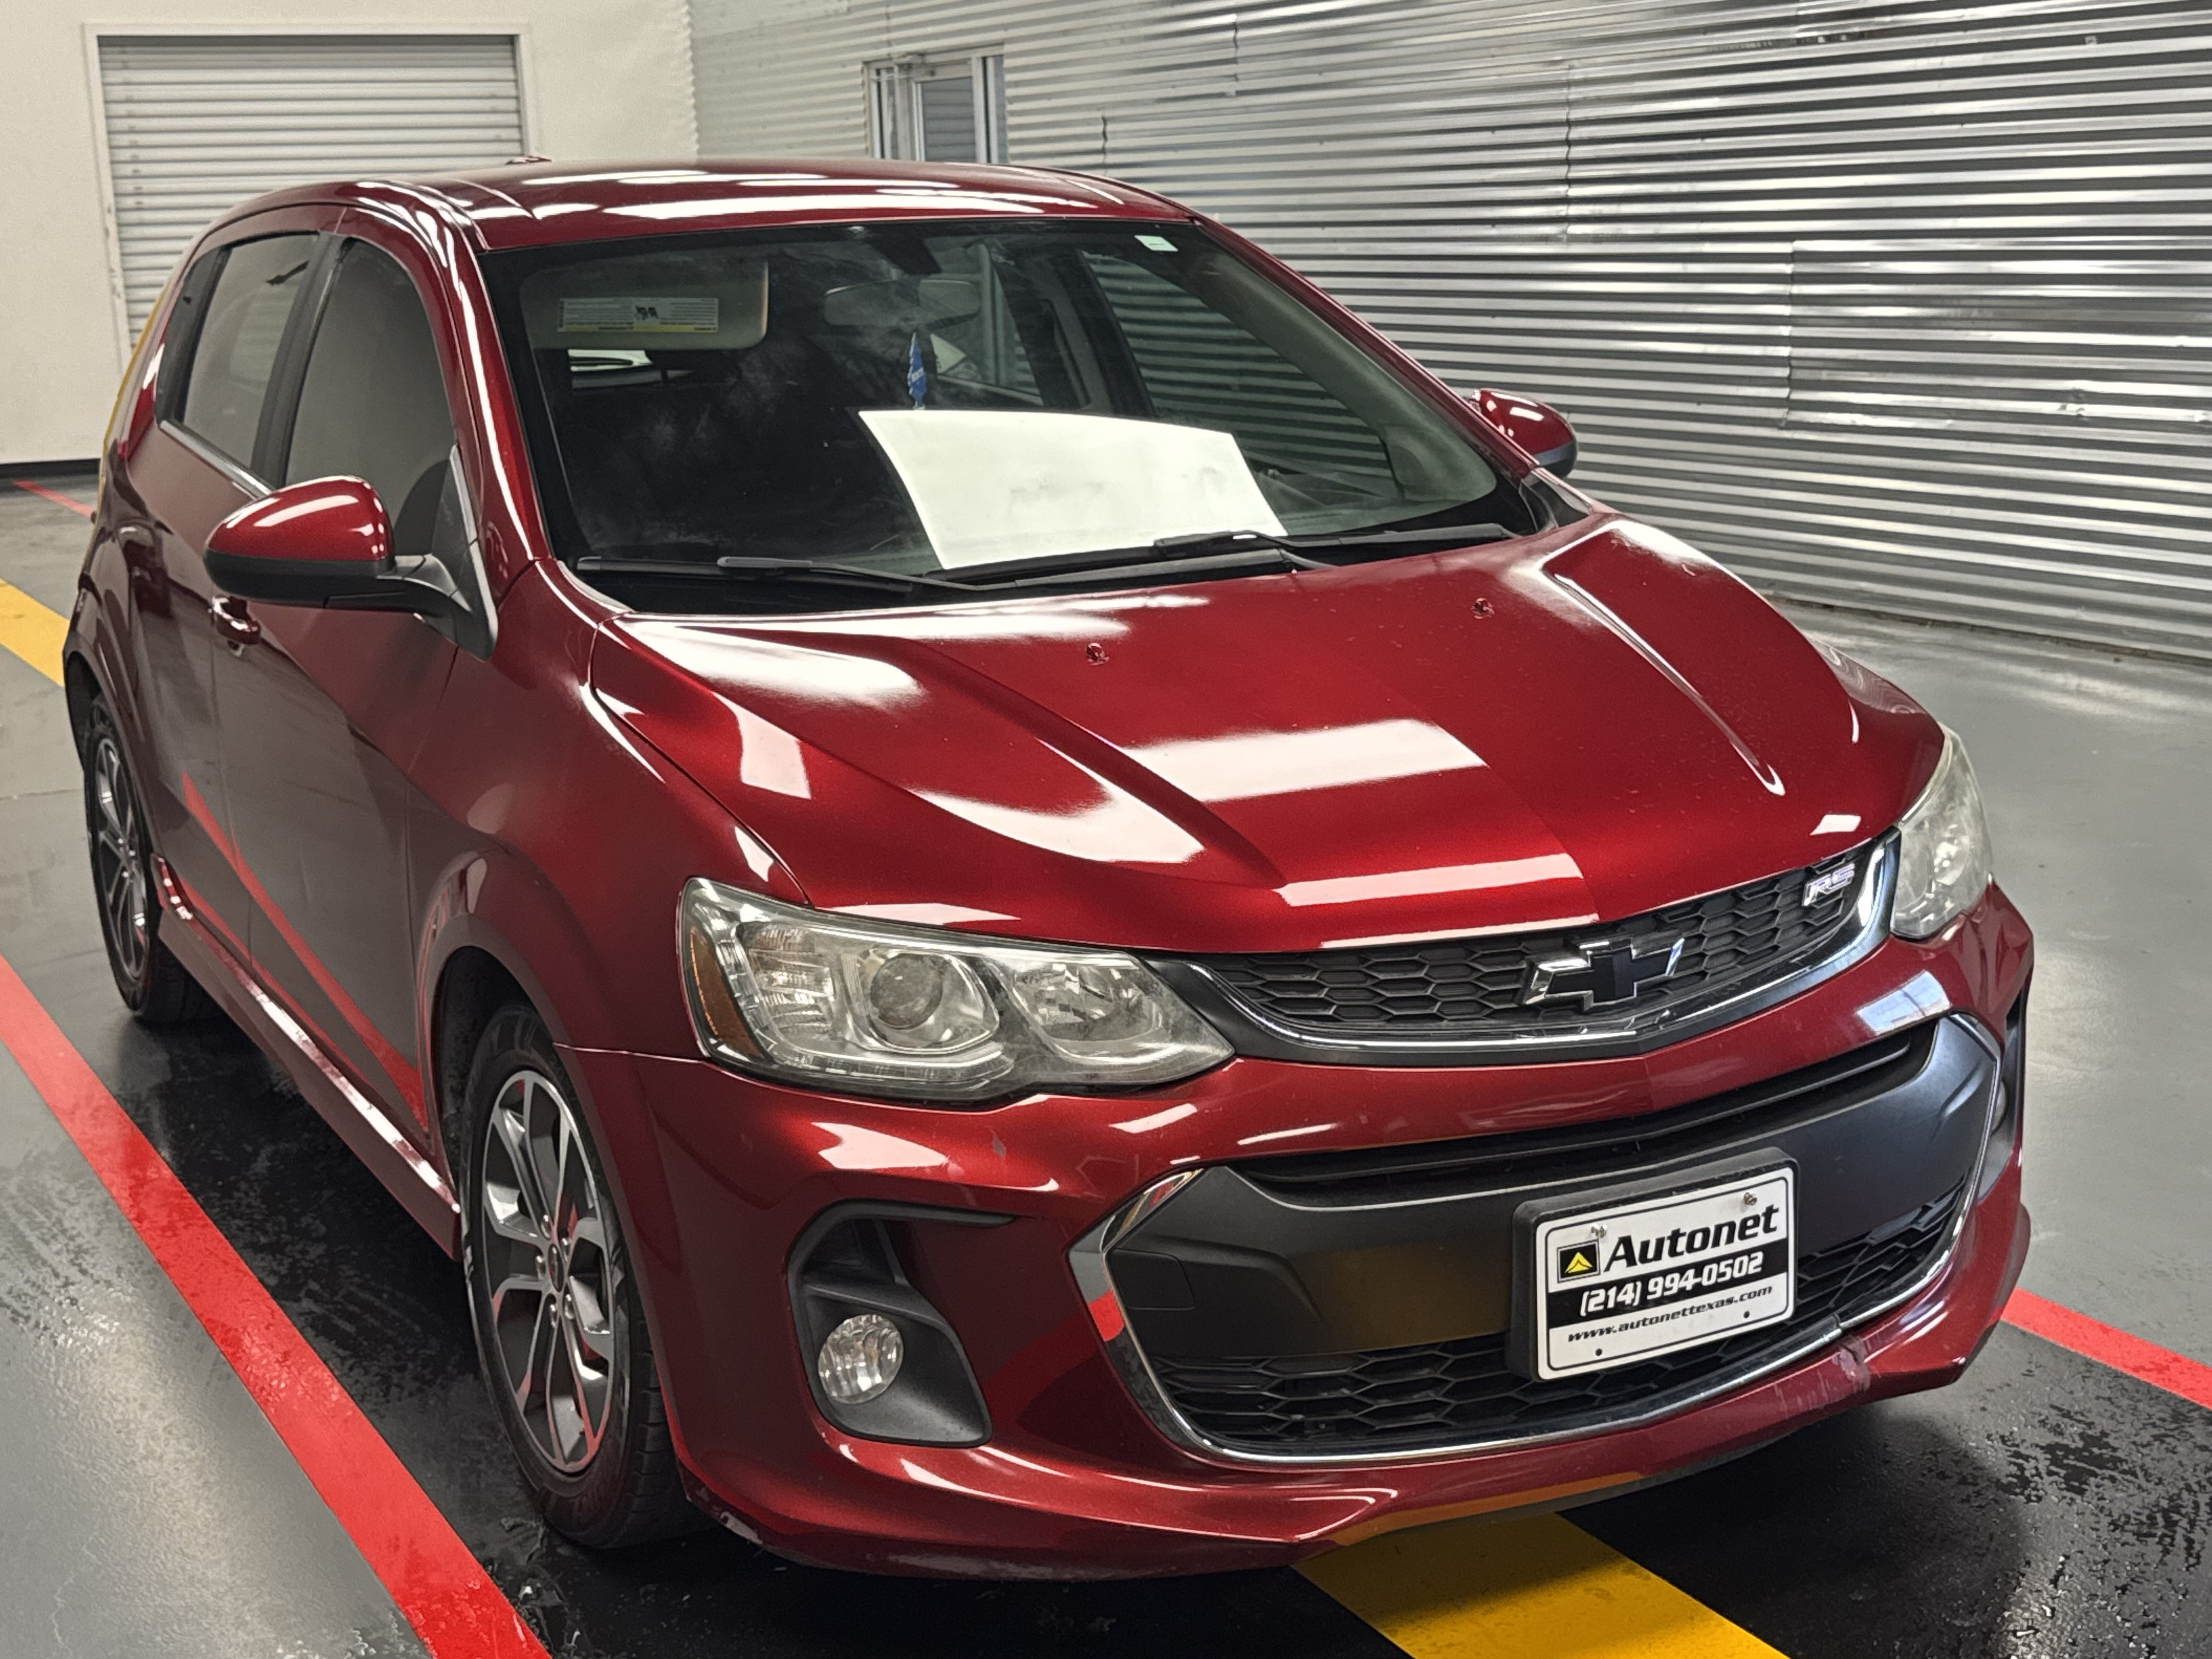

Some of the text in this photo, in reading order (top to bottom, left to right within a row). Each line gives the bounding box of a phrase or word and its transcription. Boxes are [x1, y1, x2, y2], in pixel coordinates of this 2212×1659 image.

[1802, 863, 1855, 906] RS
[1604, 1205, 1779, 1272] Autonet
[1568, 1285, 1772, 1342] www.autonettexas.com
[1580, 1251, 1763, 1316] (214) 994-0502
